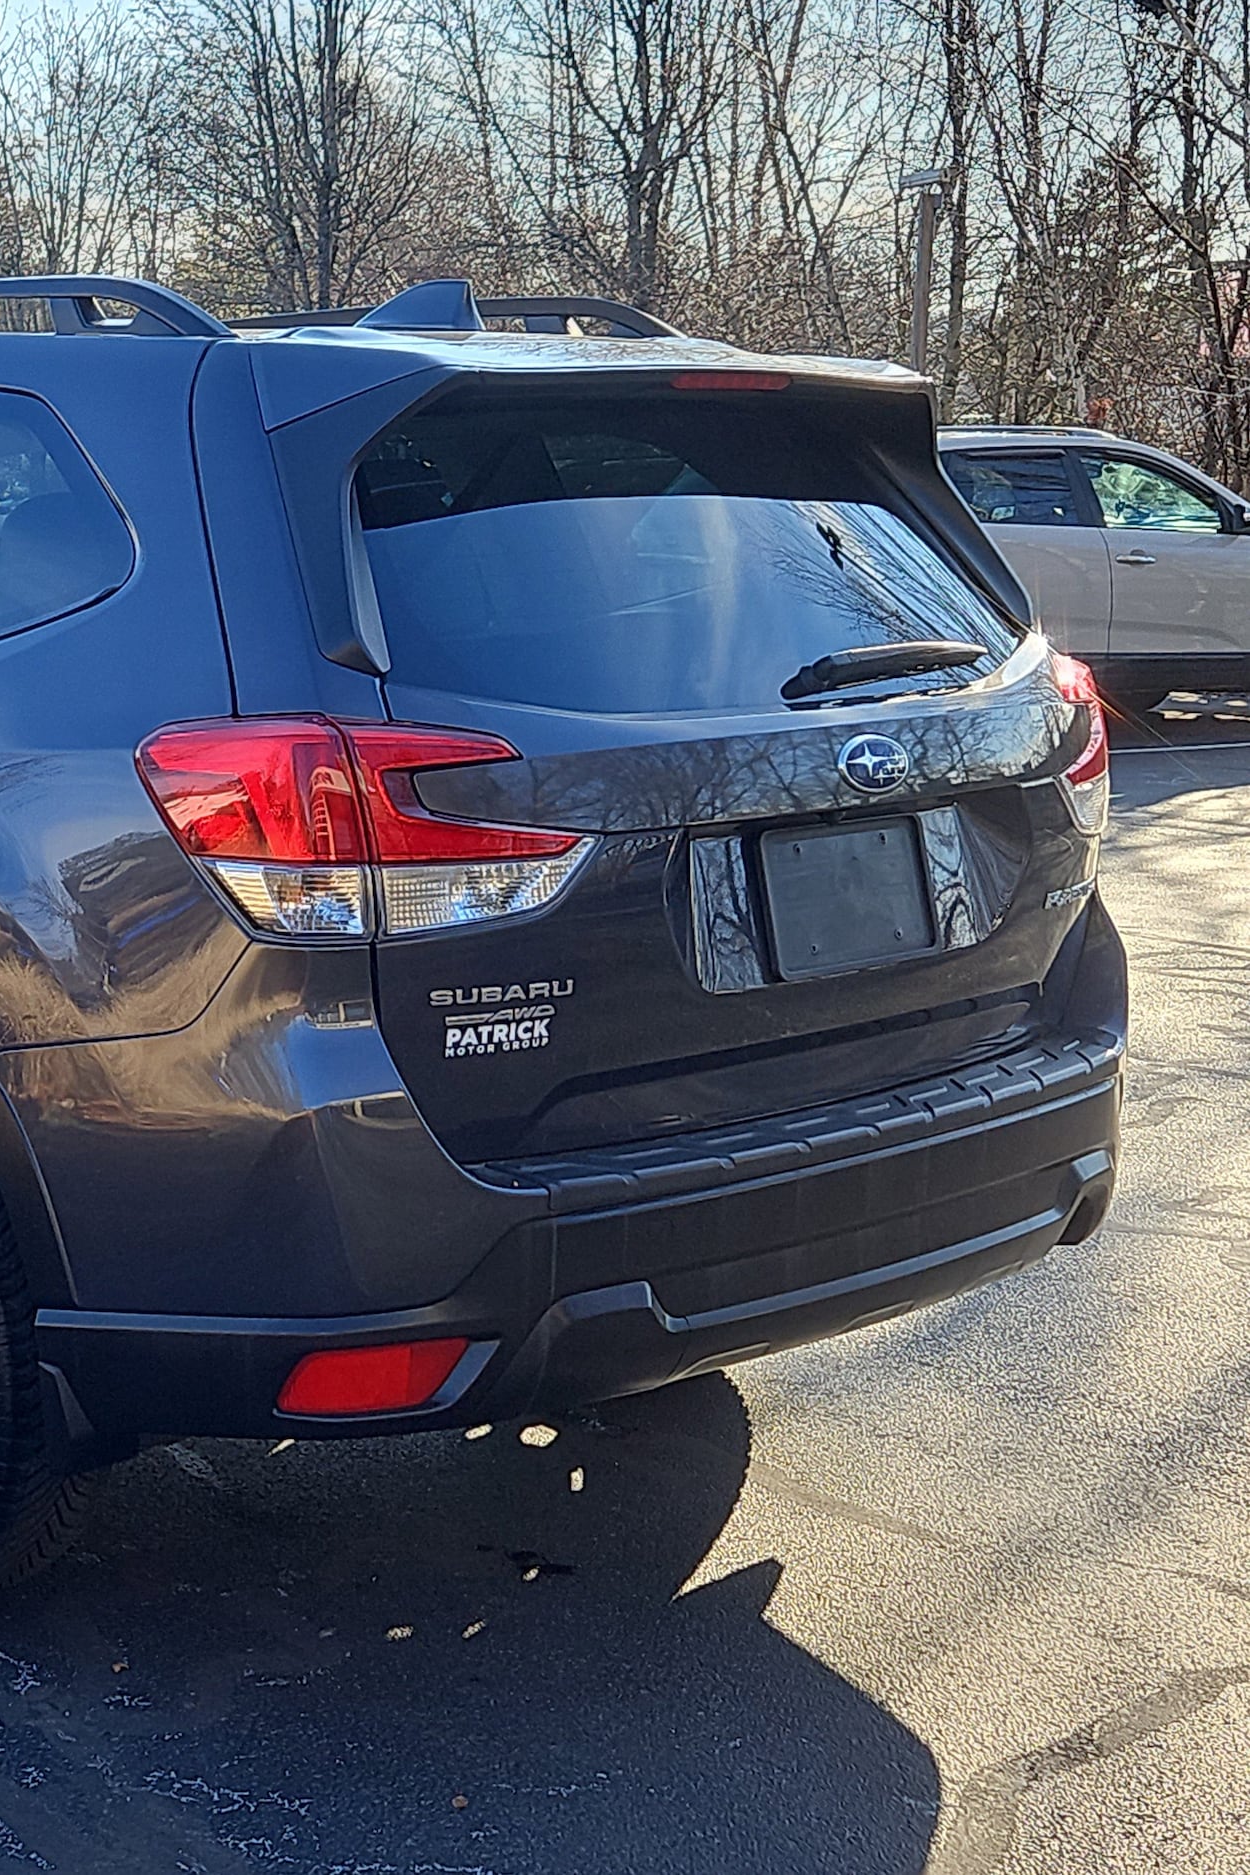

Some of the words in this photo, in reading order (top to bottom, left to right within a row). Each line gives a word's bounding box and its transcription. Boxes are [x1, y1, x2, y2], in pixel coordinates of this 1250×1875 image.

[429, 979, 574, 1007] SUBARU
[488, 1004, 556, 1023] AWD
[445, 1018, 550, 1048] PATRICK
[444, 1044, 495, 1058] MOTOR
[502, 1037, 549, 1051] GROUP
